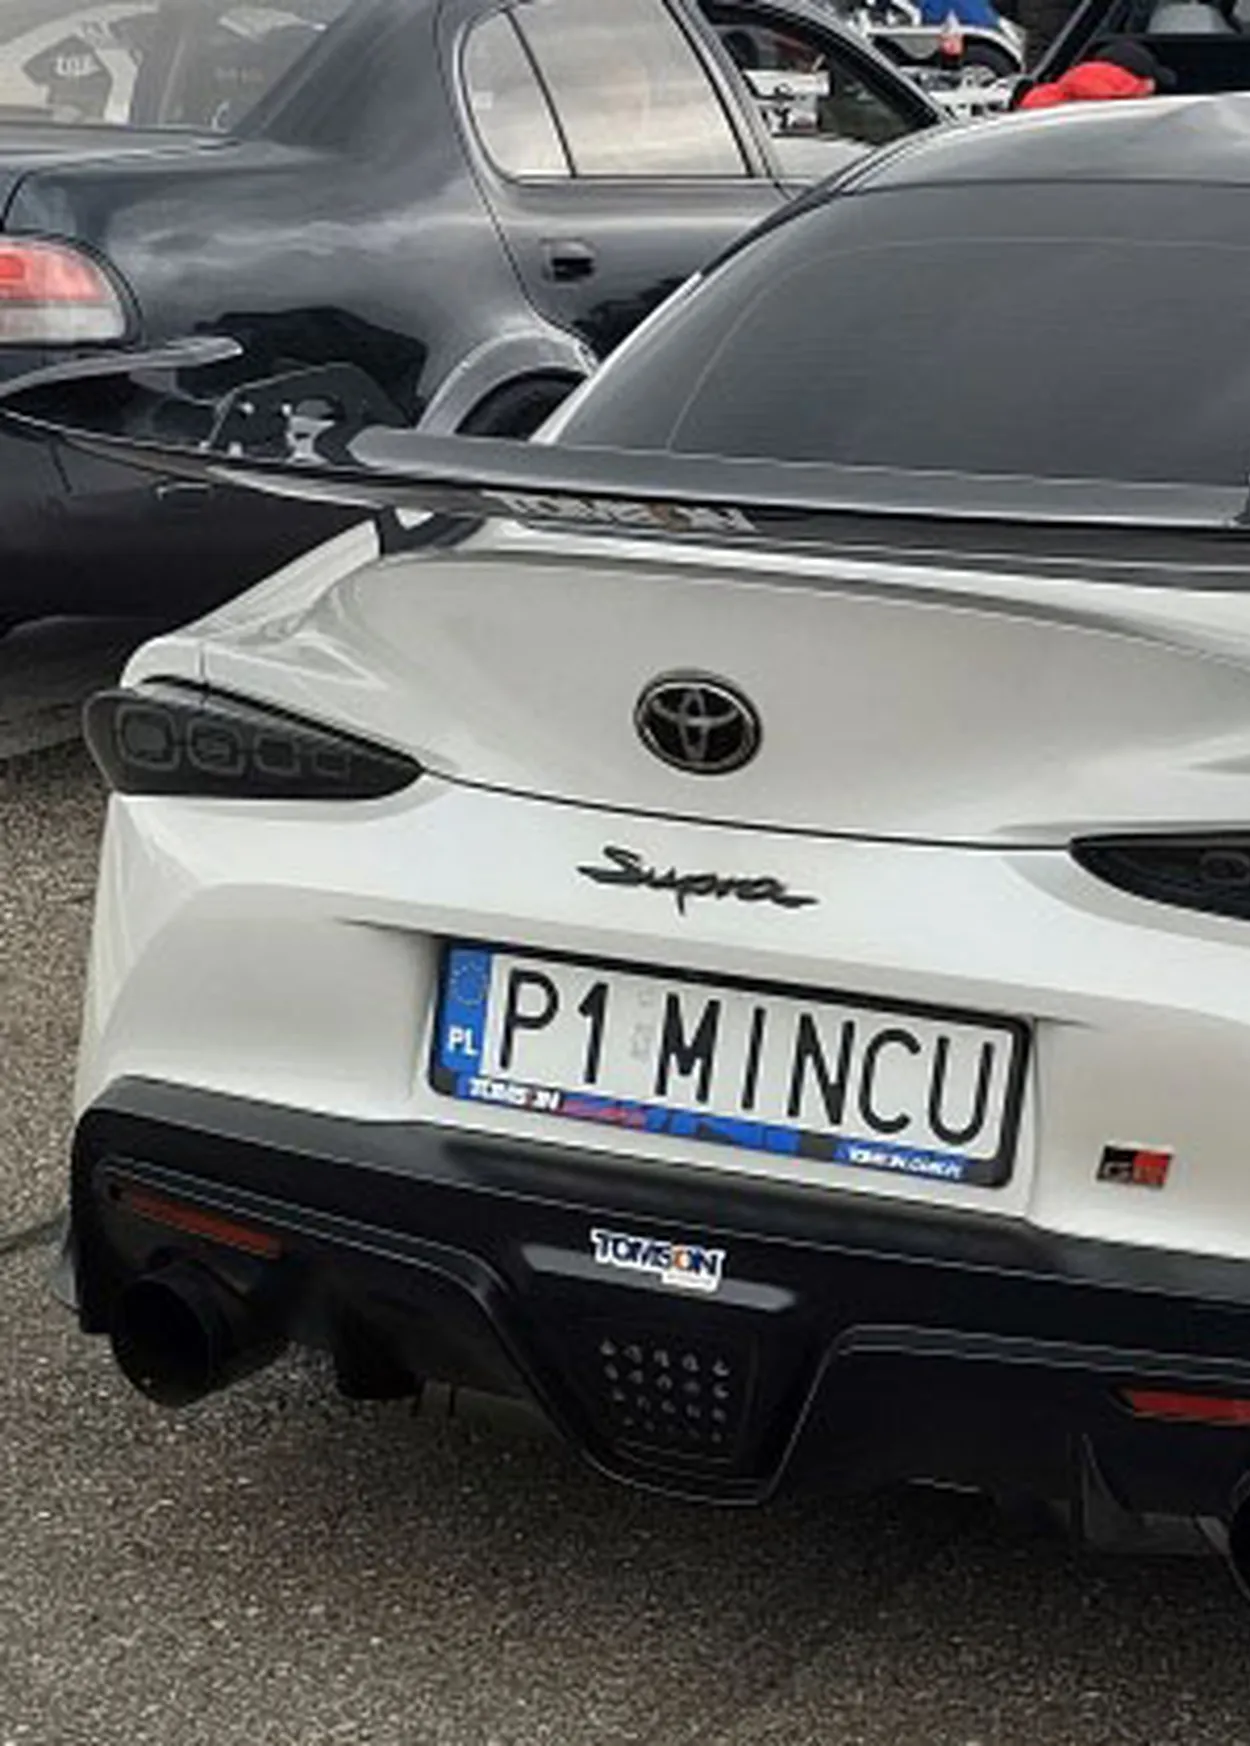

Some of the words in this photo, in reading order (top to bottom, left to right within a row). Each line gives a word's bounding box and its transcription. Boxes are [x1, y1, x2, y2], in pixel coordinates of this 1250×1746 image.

[577, 846, 819, 915] Supra
[449, 1026, 479, 1056] PL
[499, 968, 609, 1085] P1
[655, 992, 996, 1145] MINCU
[593, 1229, 723, 1277] TOMSON
